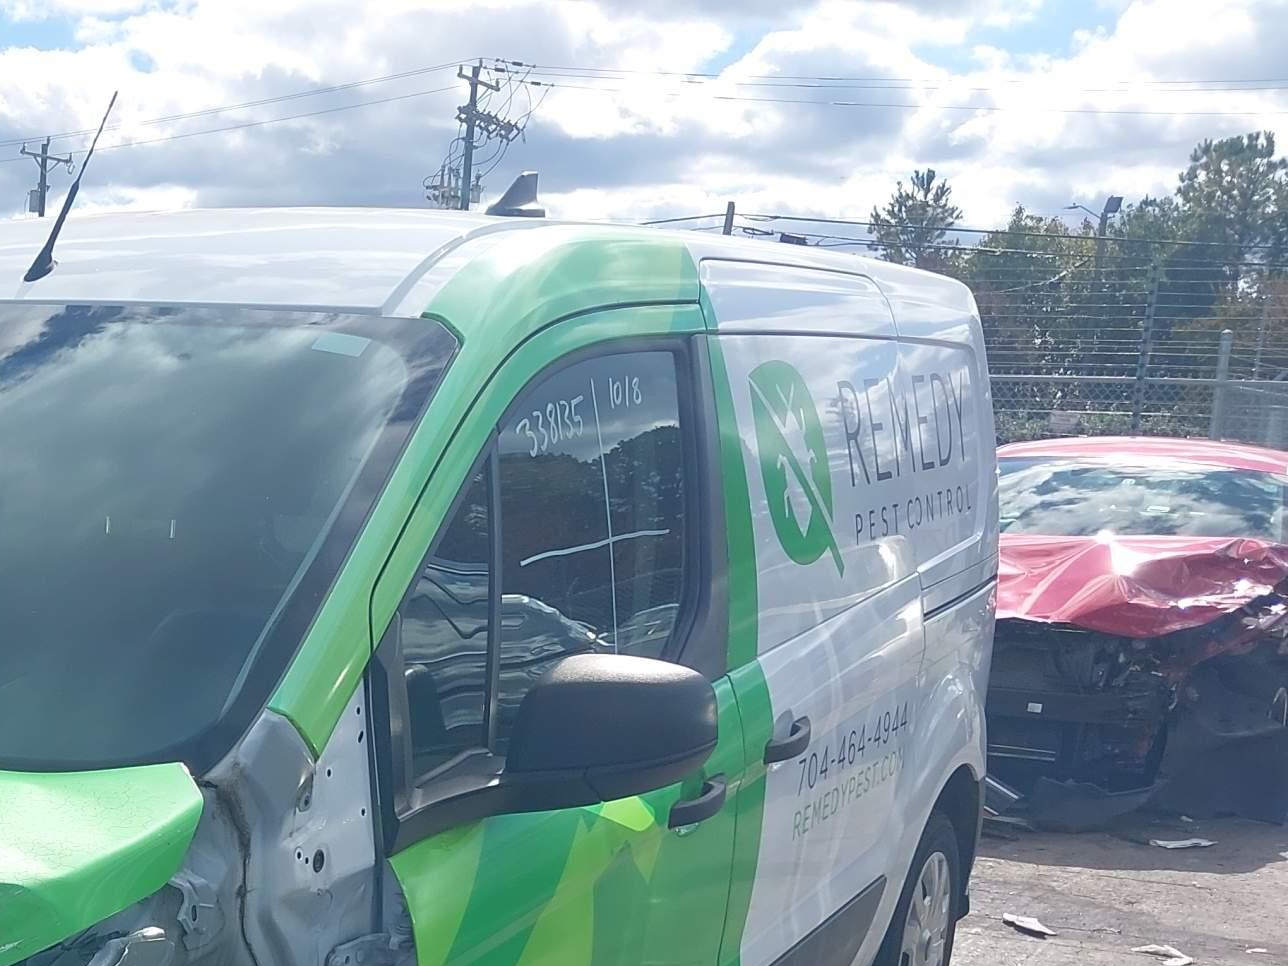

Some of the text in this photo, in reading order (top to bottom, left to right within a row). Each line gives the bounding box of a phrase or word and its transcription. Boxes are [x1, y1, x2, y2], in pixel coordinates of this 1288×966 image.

[516, 395, 584, 457] 338135
[837, 372, 966, 487] REMEDY
[855, 486, 972, 545] PEST CONTROL
[792, 747, 906, 841] REMEDYPEST.COM
[798, 702, 908, 797] 704-464-4944
